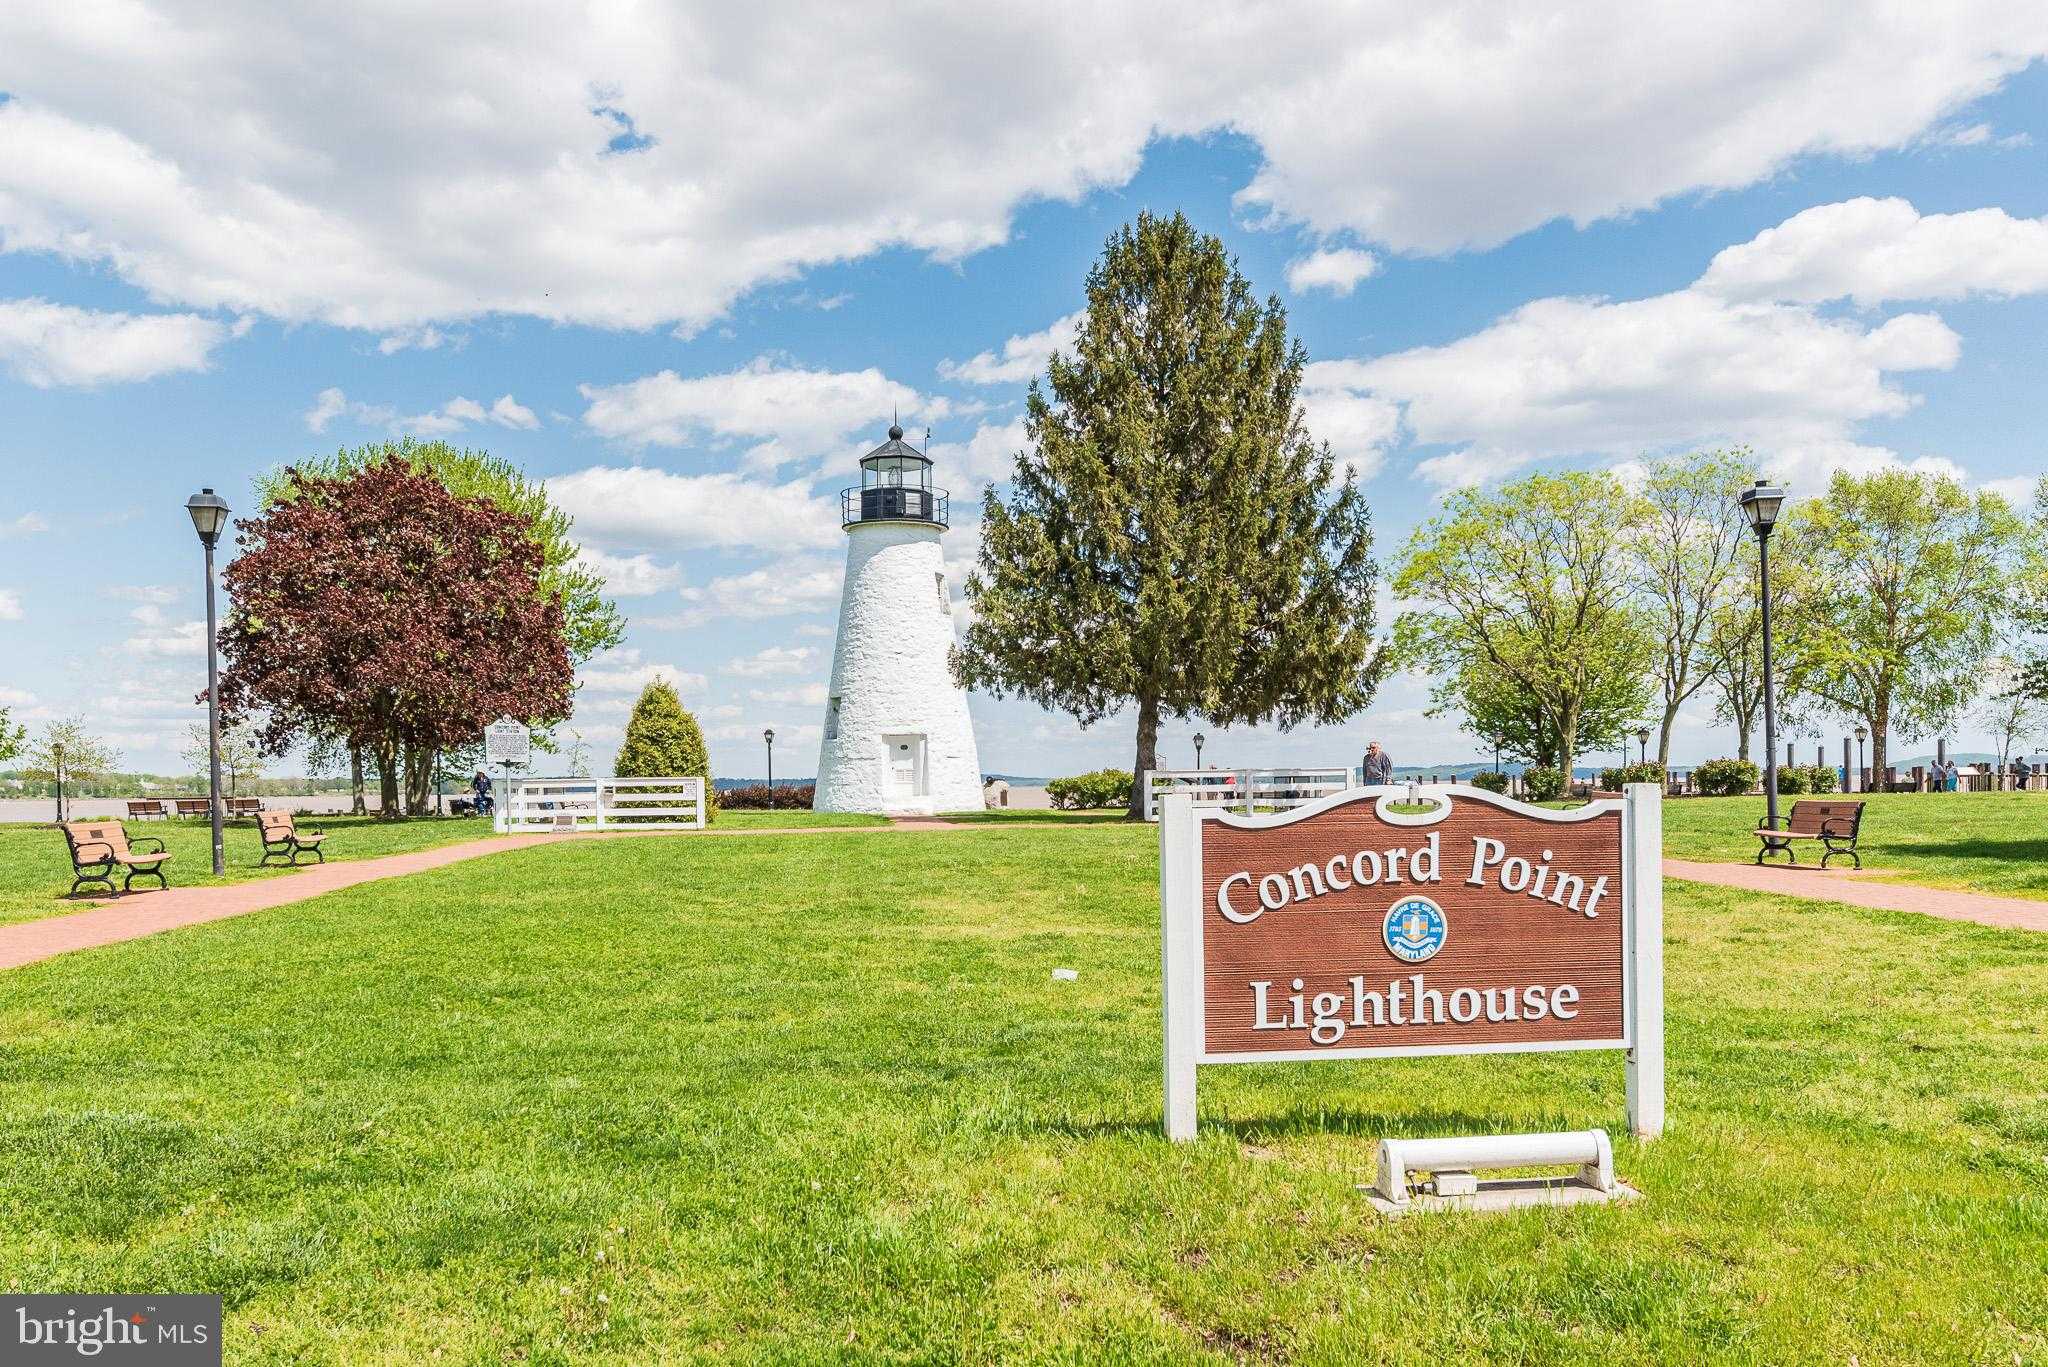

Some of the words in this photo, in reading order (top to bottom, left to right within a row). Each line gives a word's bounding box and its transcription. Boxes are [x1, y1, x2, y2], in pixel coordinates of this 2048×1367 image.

[1217, 831, 1443, 923] Concord
[1466, 836, 1609, 918] Point
[1391, 904, 1409, 923] HAVRE
[1421, 904, 1440, 923] GRACE
[1393, 942, 1436, 959] MARYLAND
[1250, 973, 1580, 1044] Lighthouse
